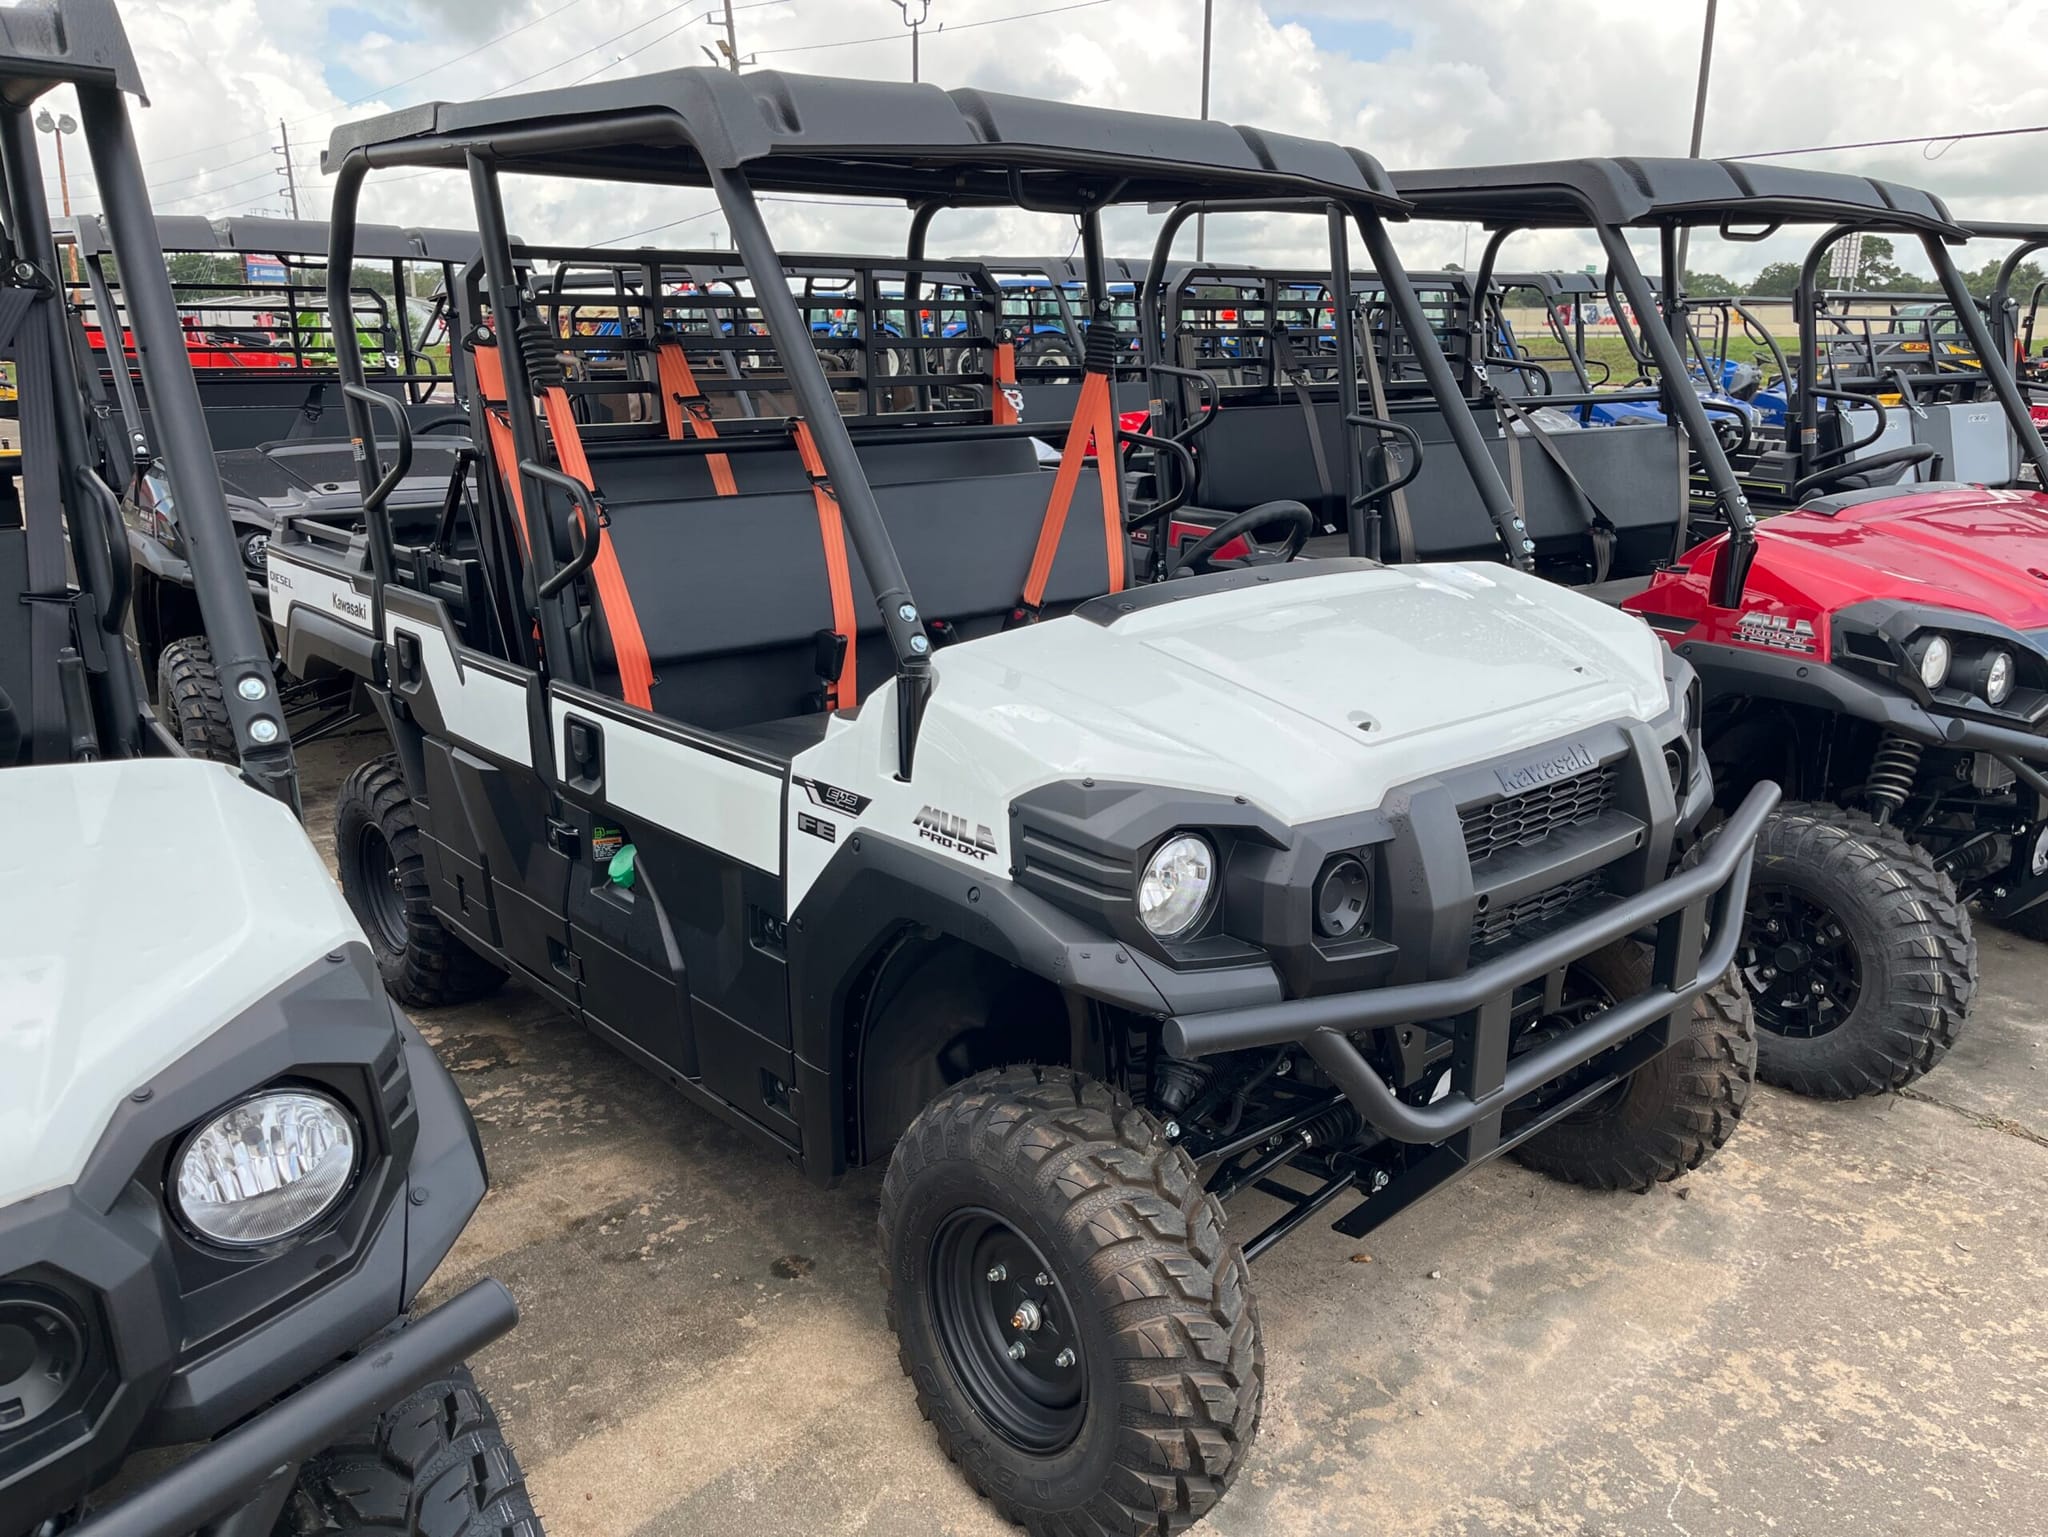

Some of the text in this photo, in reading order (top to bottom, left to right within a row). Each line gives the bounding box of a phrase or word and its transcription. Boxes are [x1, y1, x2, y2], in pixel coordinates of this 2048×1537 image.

[270, 570, 293, 589] DIESEL
[332, 591, 366, 620] Kawasaki
[1493, 743, 1595, 793] Kawasaki
[800, 814, 835, 841] FE
[912, 805, 998, 855] MULE
[919, 829, 989, 861] PRO-DXT
